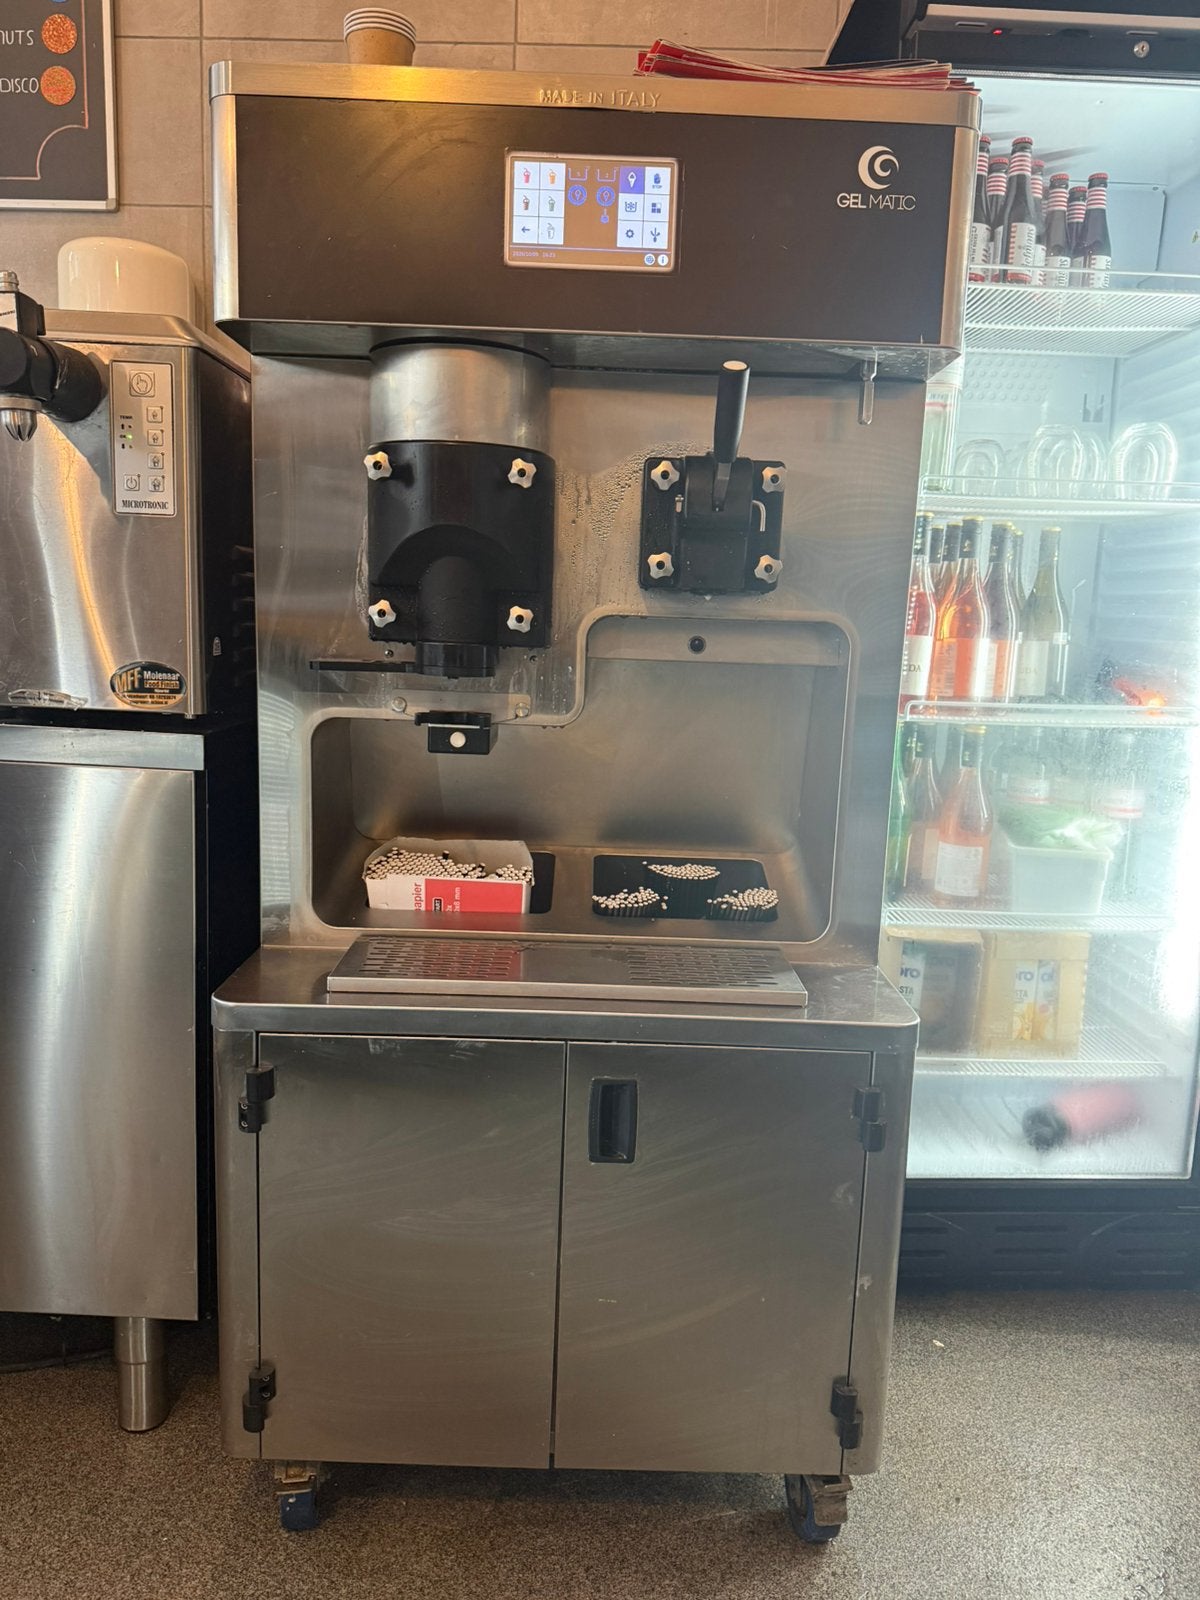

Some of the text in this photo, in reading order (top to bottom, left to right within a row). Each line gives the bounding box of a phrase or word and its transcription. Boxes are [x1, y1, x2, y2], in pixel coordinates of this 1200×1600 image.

[0, 77, 39, 94] DISCO
[539, 89, 661, 108] MADE IN ITALY
[836, 192, 916, 211] GEL MATIC
[121, 499, 169, 510] MICROTRONIC
[114, 667, 142, 693] MFF
[143, 670, 180, 681] Molenaar
[454, 887, 461, 900] mm
